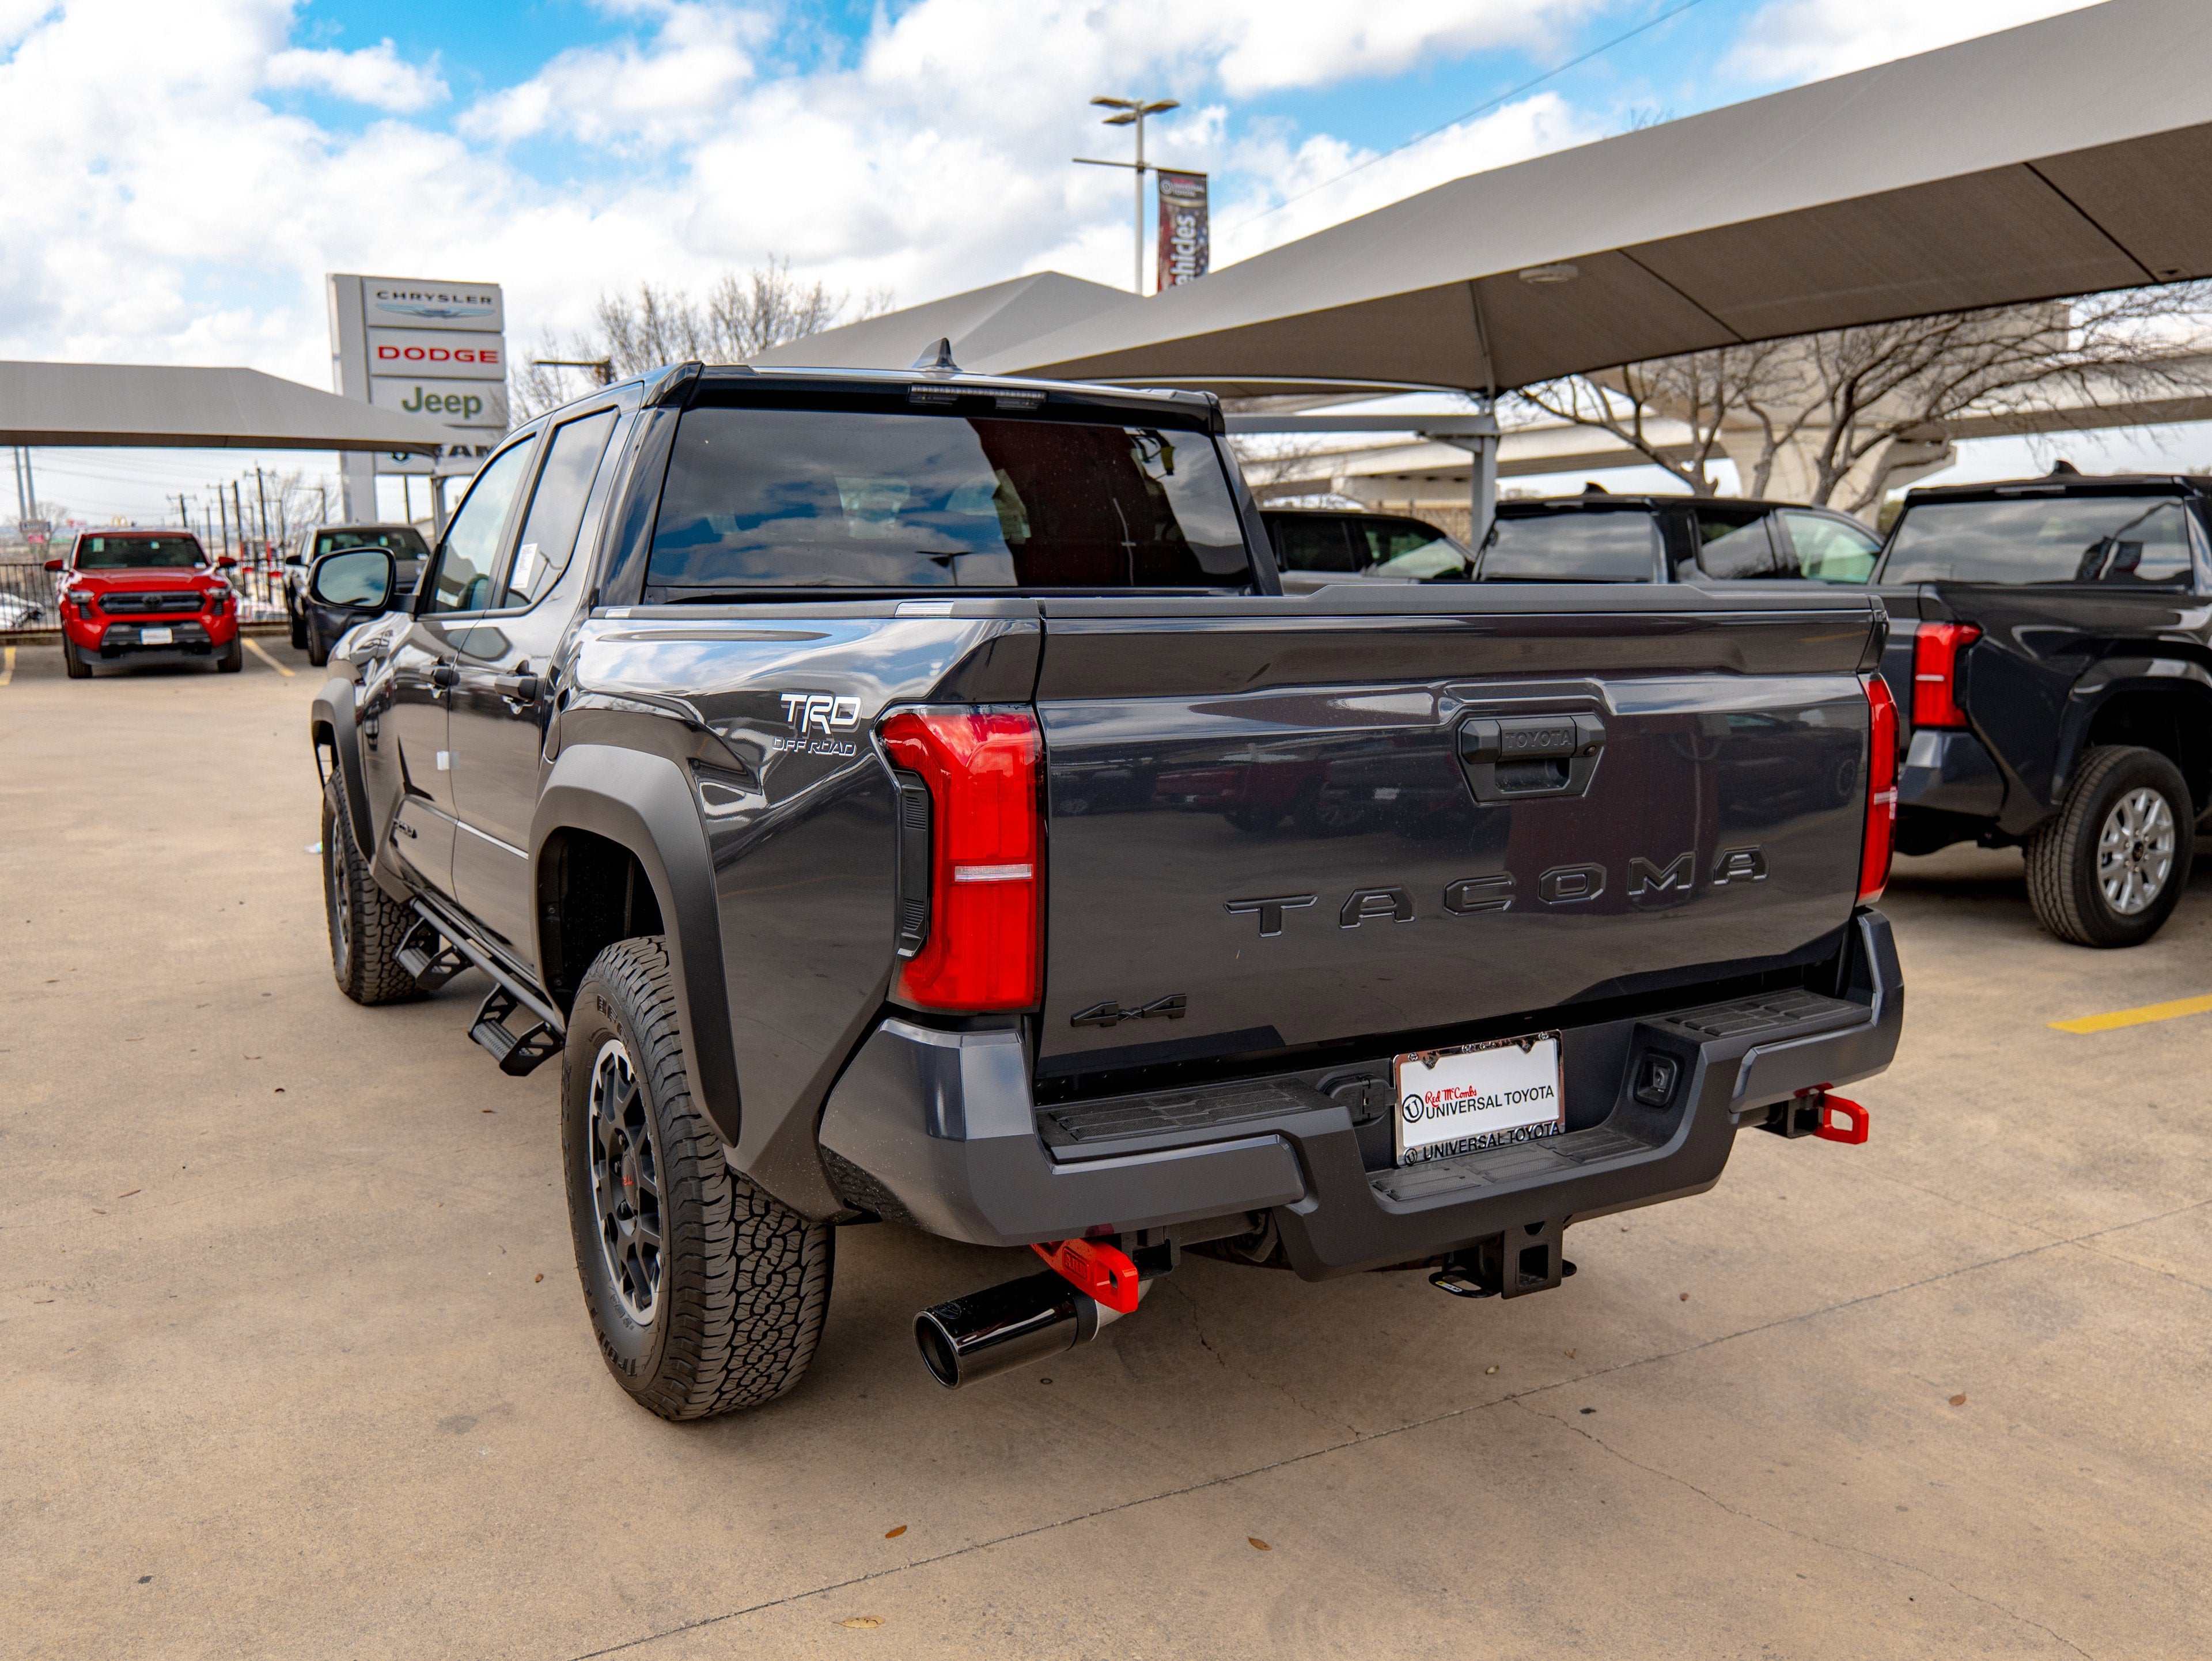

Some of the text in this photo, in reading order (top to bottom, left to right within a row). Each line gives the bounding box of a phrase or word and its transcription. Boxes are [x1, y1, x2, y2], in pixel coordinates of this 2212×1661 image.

[376, 290, 492, 304] CHRYSLER
[378, 346, 499, 364] DODGE
[402, 386, 482, 419] Jeep
[781, 693, 862, 735] TRD
[772, 737, 857, 757] OFF ROAD
[1505, 730, 1572, 749] TOYOTA
[1224, 844, 1770, 938] TACOMA
[1425, 1092, 1441, 1107] Red
[1426, 1085, 1554, 1119] UNIVERSAL TOYOTA
[1423, 1132, 1505, 1160] UNIVERSAL
[1507, 1121, 1560, 1142] TOYOTA
